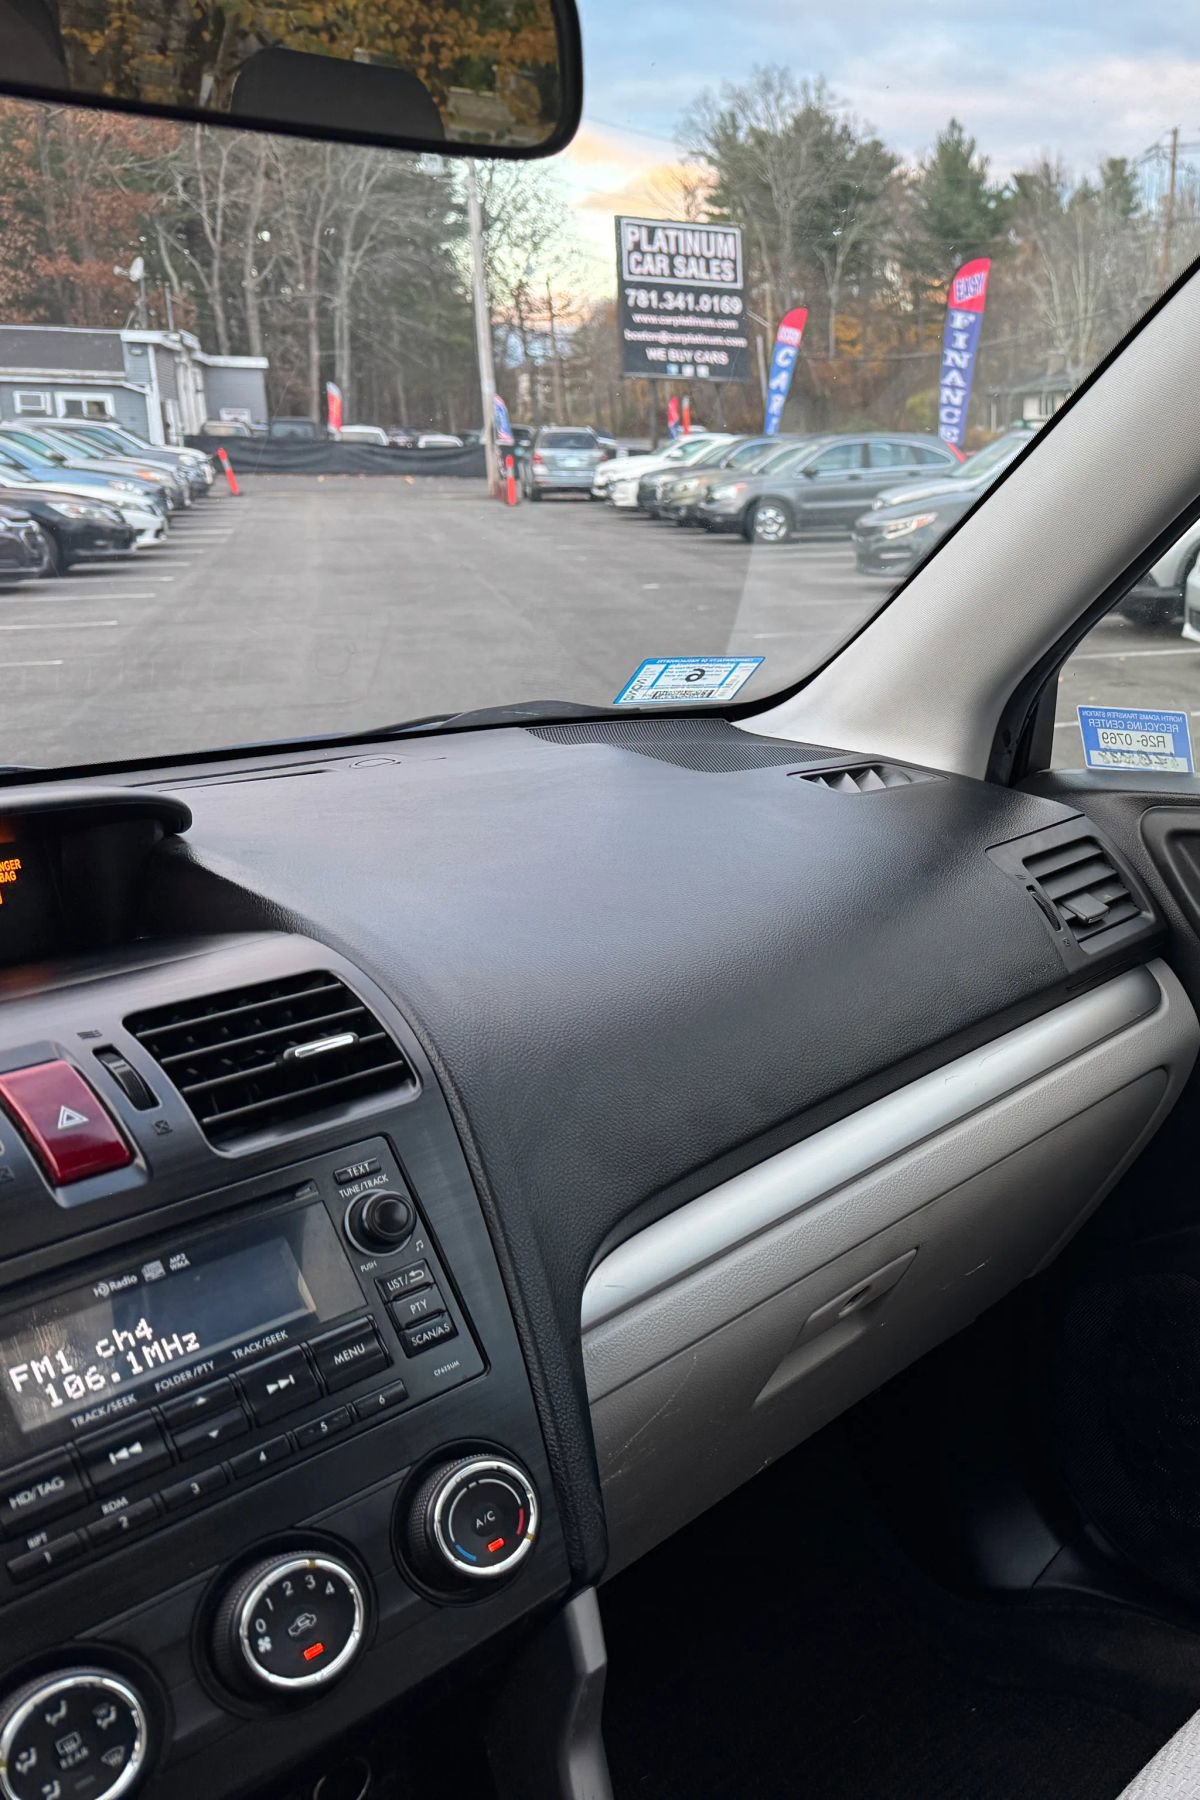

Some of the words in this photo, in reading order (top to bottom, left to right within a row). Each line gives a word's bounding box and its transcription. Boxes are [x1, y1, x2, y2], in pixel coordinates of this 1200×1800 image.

[626, 225, 736, 260] PLATINUM
[629, 251, 670, 277] CAR
[673, 256, 735, 282] SALES
[955, 273, 985, 300] EASY
[645, 347, 667, 361] WE
[668, 348, 693, 362] BUY
[693, 350, 729, 365] CARS
[939, 312, 976, 443] FINANCE
[347, 1163, 370, 1178] TEXT
[338, 1173, 389, 1199] TUNE/TRACK
[360, 1260, 378, 1273] PUSH
[109, 1275, 139, 1292] Radio
[409, 1299, 428, 1315] PTY
[9, 1350, 73, 1392] FM1
[95, 1317, 153, 1358] ch4
[231, 1330, 289, 1361] TRACK/SEEK
[333, 1343, 366, 1366] MENU
[45, 1332, 200, 1408] 106.1MHz
[154, 1361, 215, 1393] FOLDER/PTY
[378, 1394, 386, 1405] 6
[71, 1393, 137, 1428] TRACK/SEEK
[320, 1421, 328, 1432] 5
[259, 1450, 267, 1462] 4
[9, 1476, 66, 1510] HD/TAG
[190, 1482, 200, 1495] 3
[101, 1496, 129, 1515] RDM
[119, 1516, 130, 1528] 2
[476, 1510, 496, 1528] A/C
[26, 1532, 48, 1550] RPT
[43, 1551, 51, 1564] 1
[282, 1580, 294, 1596] 2
[305, 1574, 316, 1590] 3
[325, 1580, 335, 1595] 4
[265, 1597, 274, 1611] 1
[255, 1618, 267, 1633] 0
